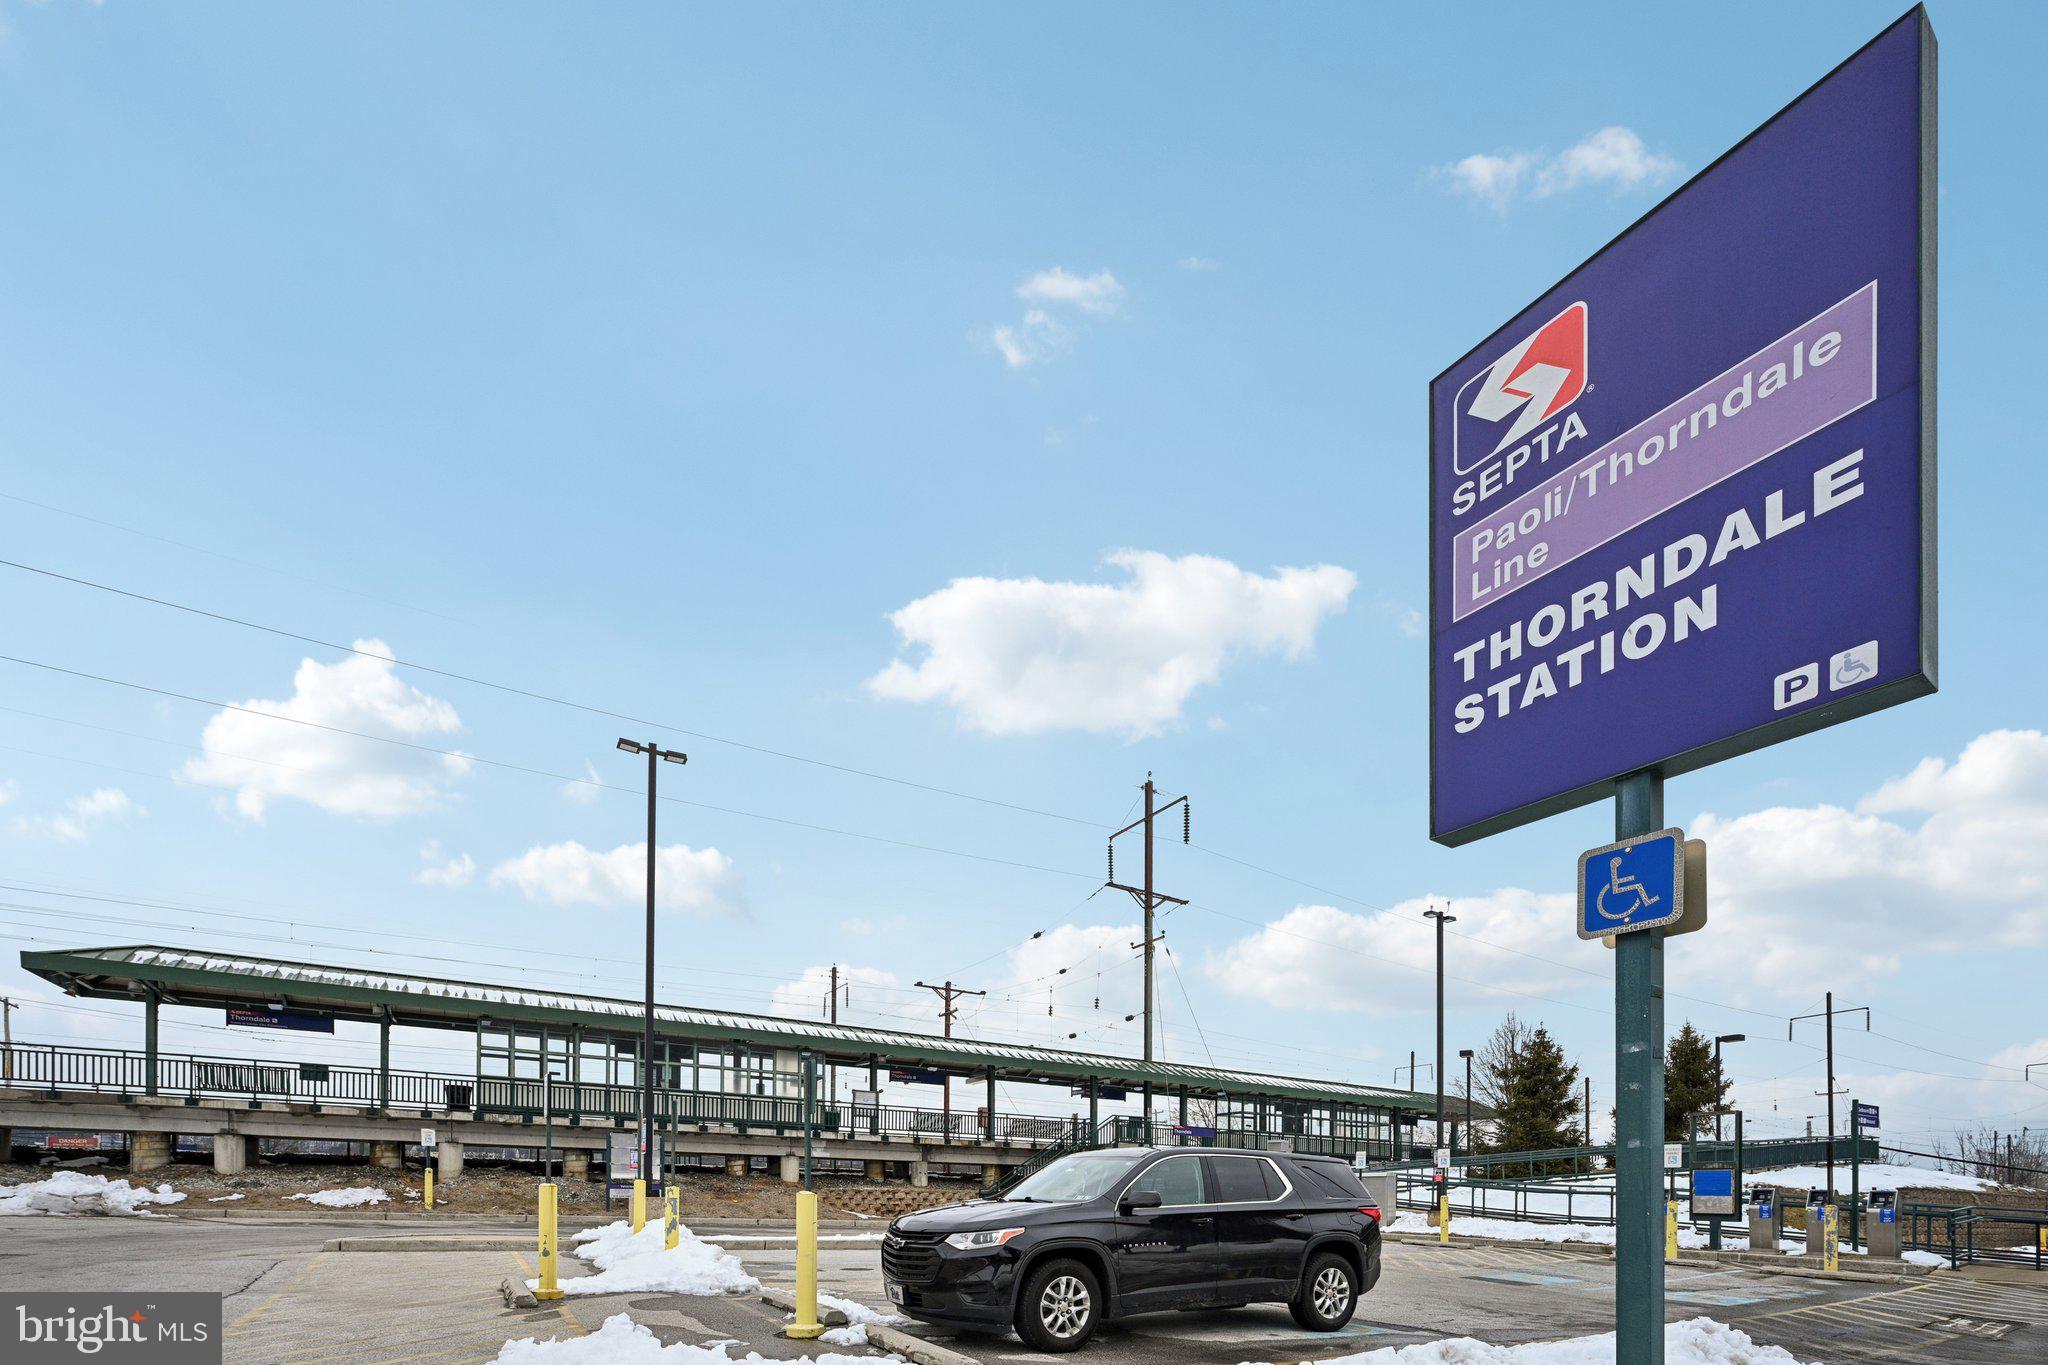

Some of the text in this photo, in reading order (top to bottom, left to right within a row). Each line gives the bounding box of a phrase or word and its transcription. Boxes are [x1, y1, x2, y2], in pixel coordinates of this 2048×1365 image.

[1452, 411, 1588, 516] SEPTA
[1471, 330, 1843, 563] Paoli/Thorndale
[1453, 448, 1865, 684] THORNDALE
[1471, 540, 1549, 601] Line
[1454, 584, 1717, 734] STATION
[1784, 675, 1809, 704] P
[231, 1015, 270, 1023] Thorndale
